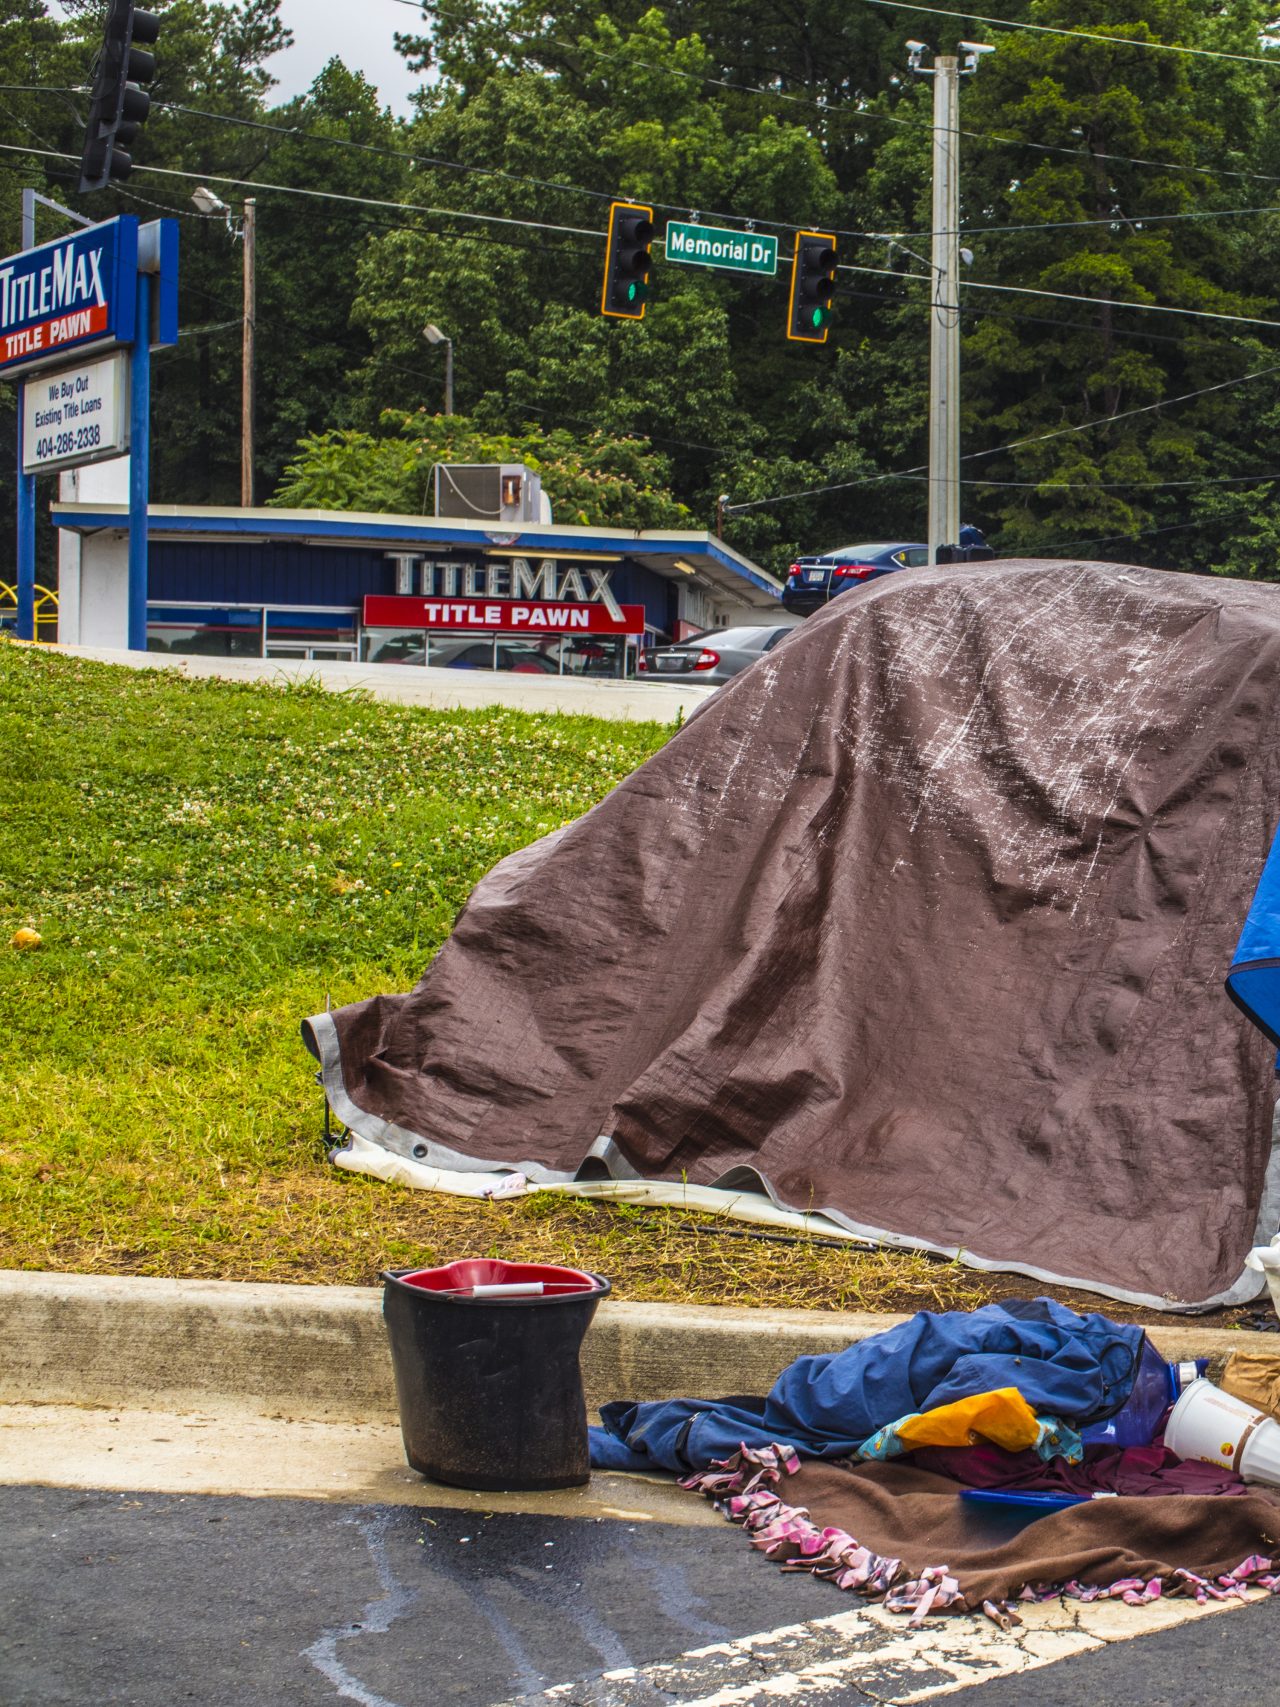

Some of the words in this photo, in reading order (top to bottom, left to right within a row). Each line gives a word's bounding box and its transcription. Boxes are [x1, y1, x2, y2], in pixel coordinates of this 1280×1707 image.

[671, 231, 748, 261] Memorial
[751, 243, 771, 264] Dr
[5, 326, 43, 358] TITLE
[50, 310, 91, 345] PAWN
[48, 384, 60, 402] We
[61, 381, 74, 399] Buy
[76, 375, 89, 393] Out
[35, 408, 62, 428] Existing
[64, 402, 79, 420] Title
[81, 397, 102, 415] Loans
[36, 424, 101, 460] 404-286-2338
[424, 603, 502, 624] TITLE
[511, 606, 590, 628] PAWN
